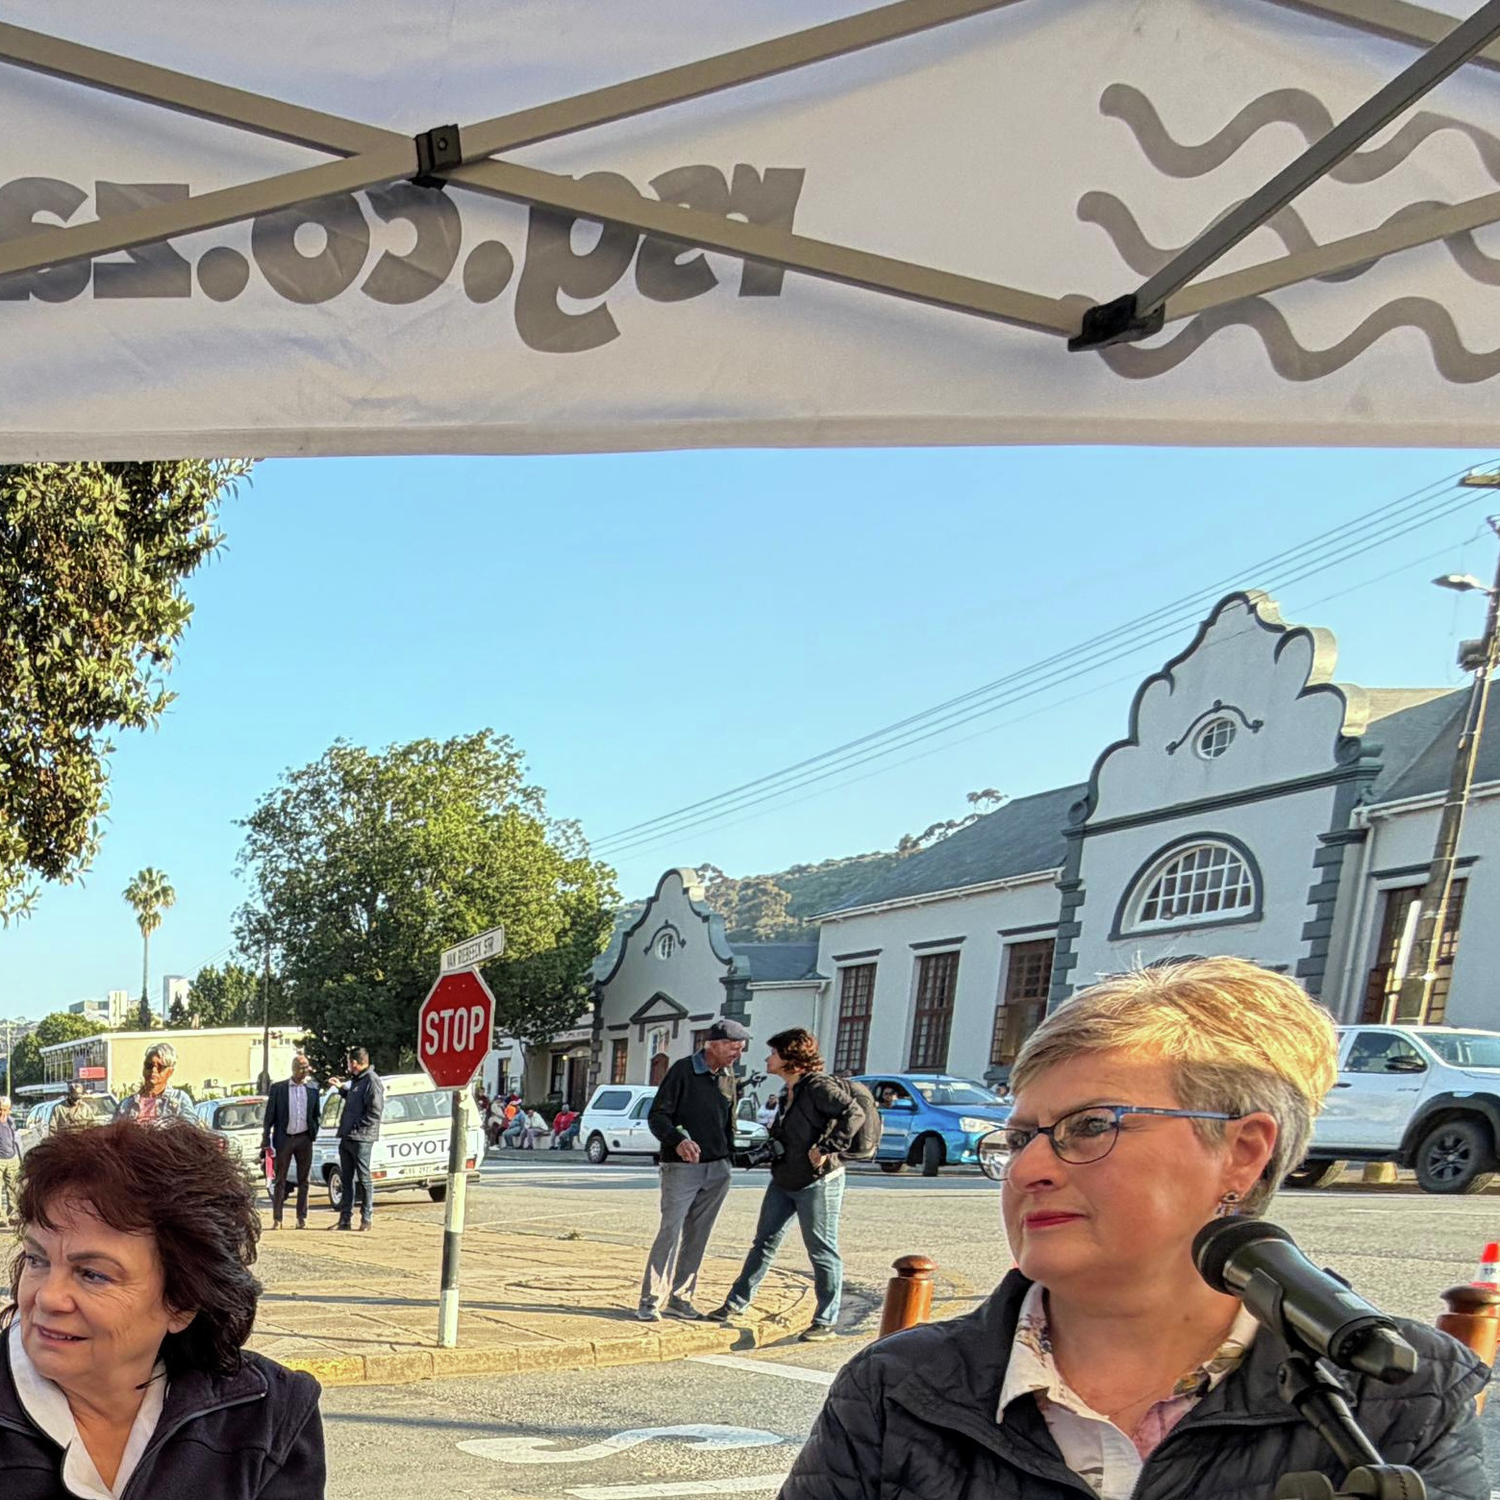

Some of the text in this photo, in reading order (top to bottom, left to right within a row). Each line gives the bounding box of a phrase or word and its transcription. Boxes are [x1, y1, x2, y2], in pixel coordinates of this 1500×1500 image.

[447, 953, 457, 968] VAN
[483, 936, 494, 956] STR
[425, 1005, 485, 1055] STOP
[387, 1139, 450, 1158] TOYOT
